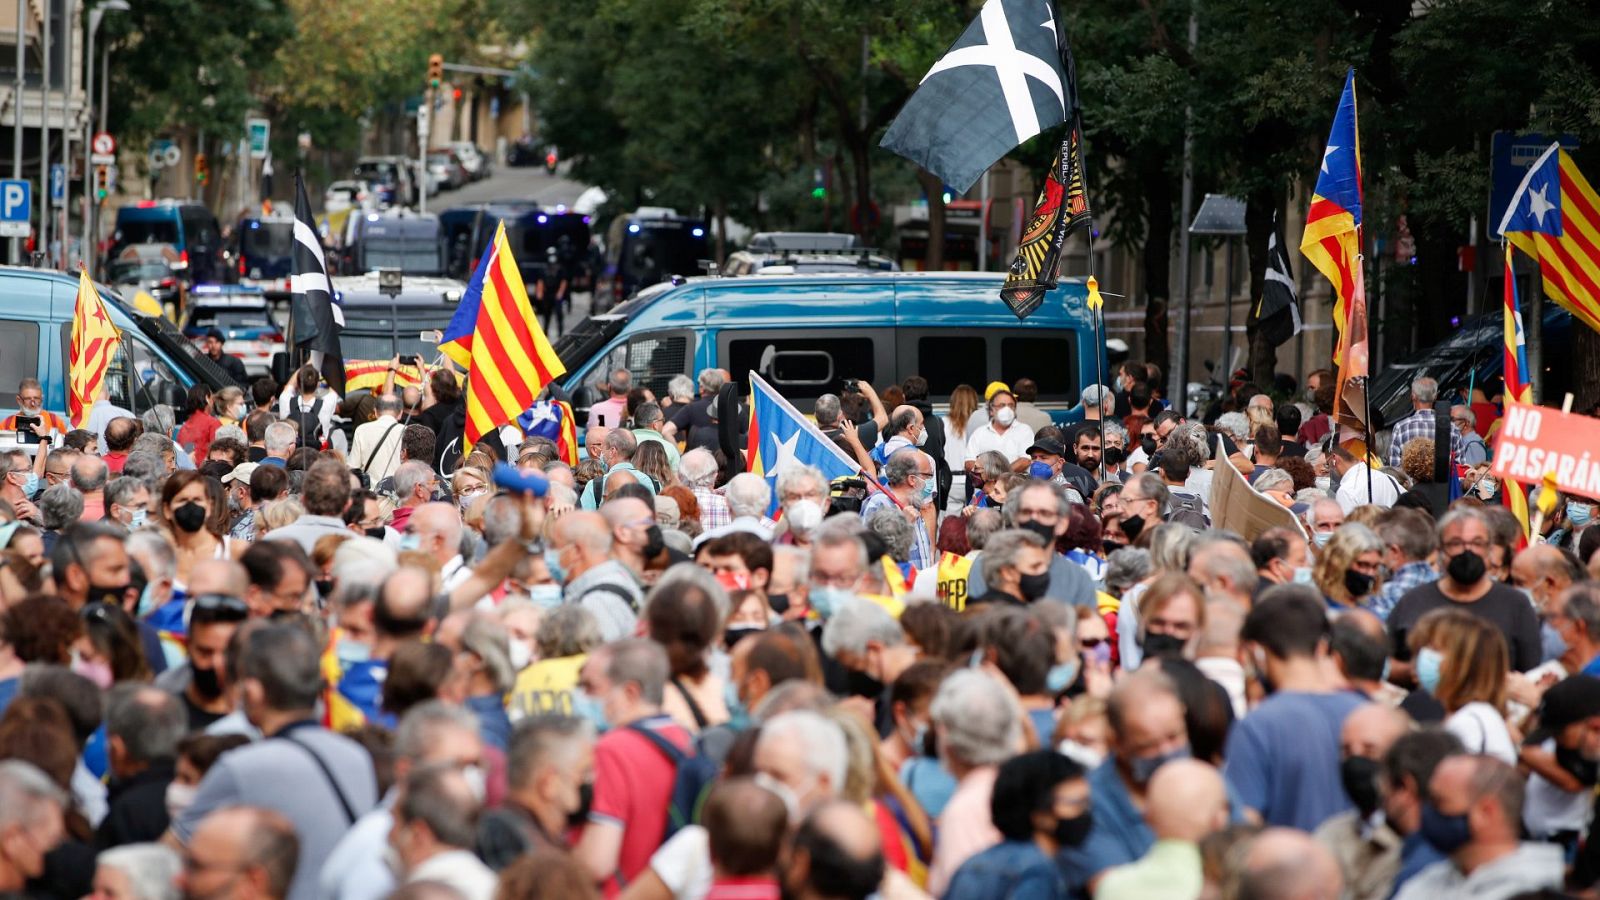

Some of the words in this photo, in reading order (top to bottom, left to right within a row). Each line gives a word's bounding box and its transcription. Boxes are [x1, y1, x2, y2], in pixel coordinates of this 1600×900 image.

[1061, 140, 1069, 185] REPUBL
[5, 184, 24, 218] P
[1504, 406, 1542, 442] NO
[1495, 441, 1600, 496] PASARÁN
